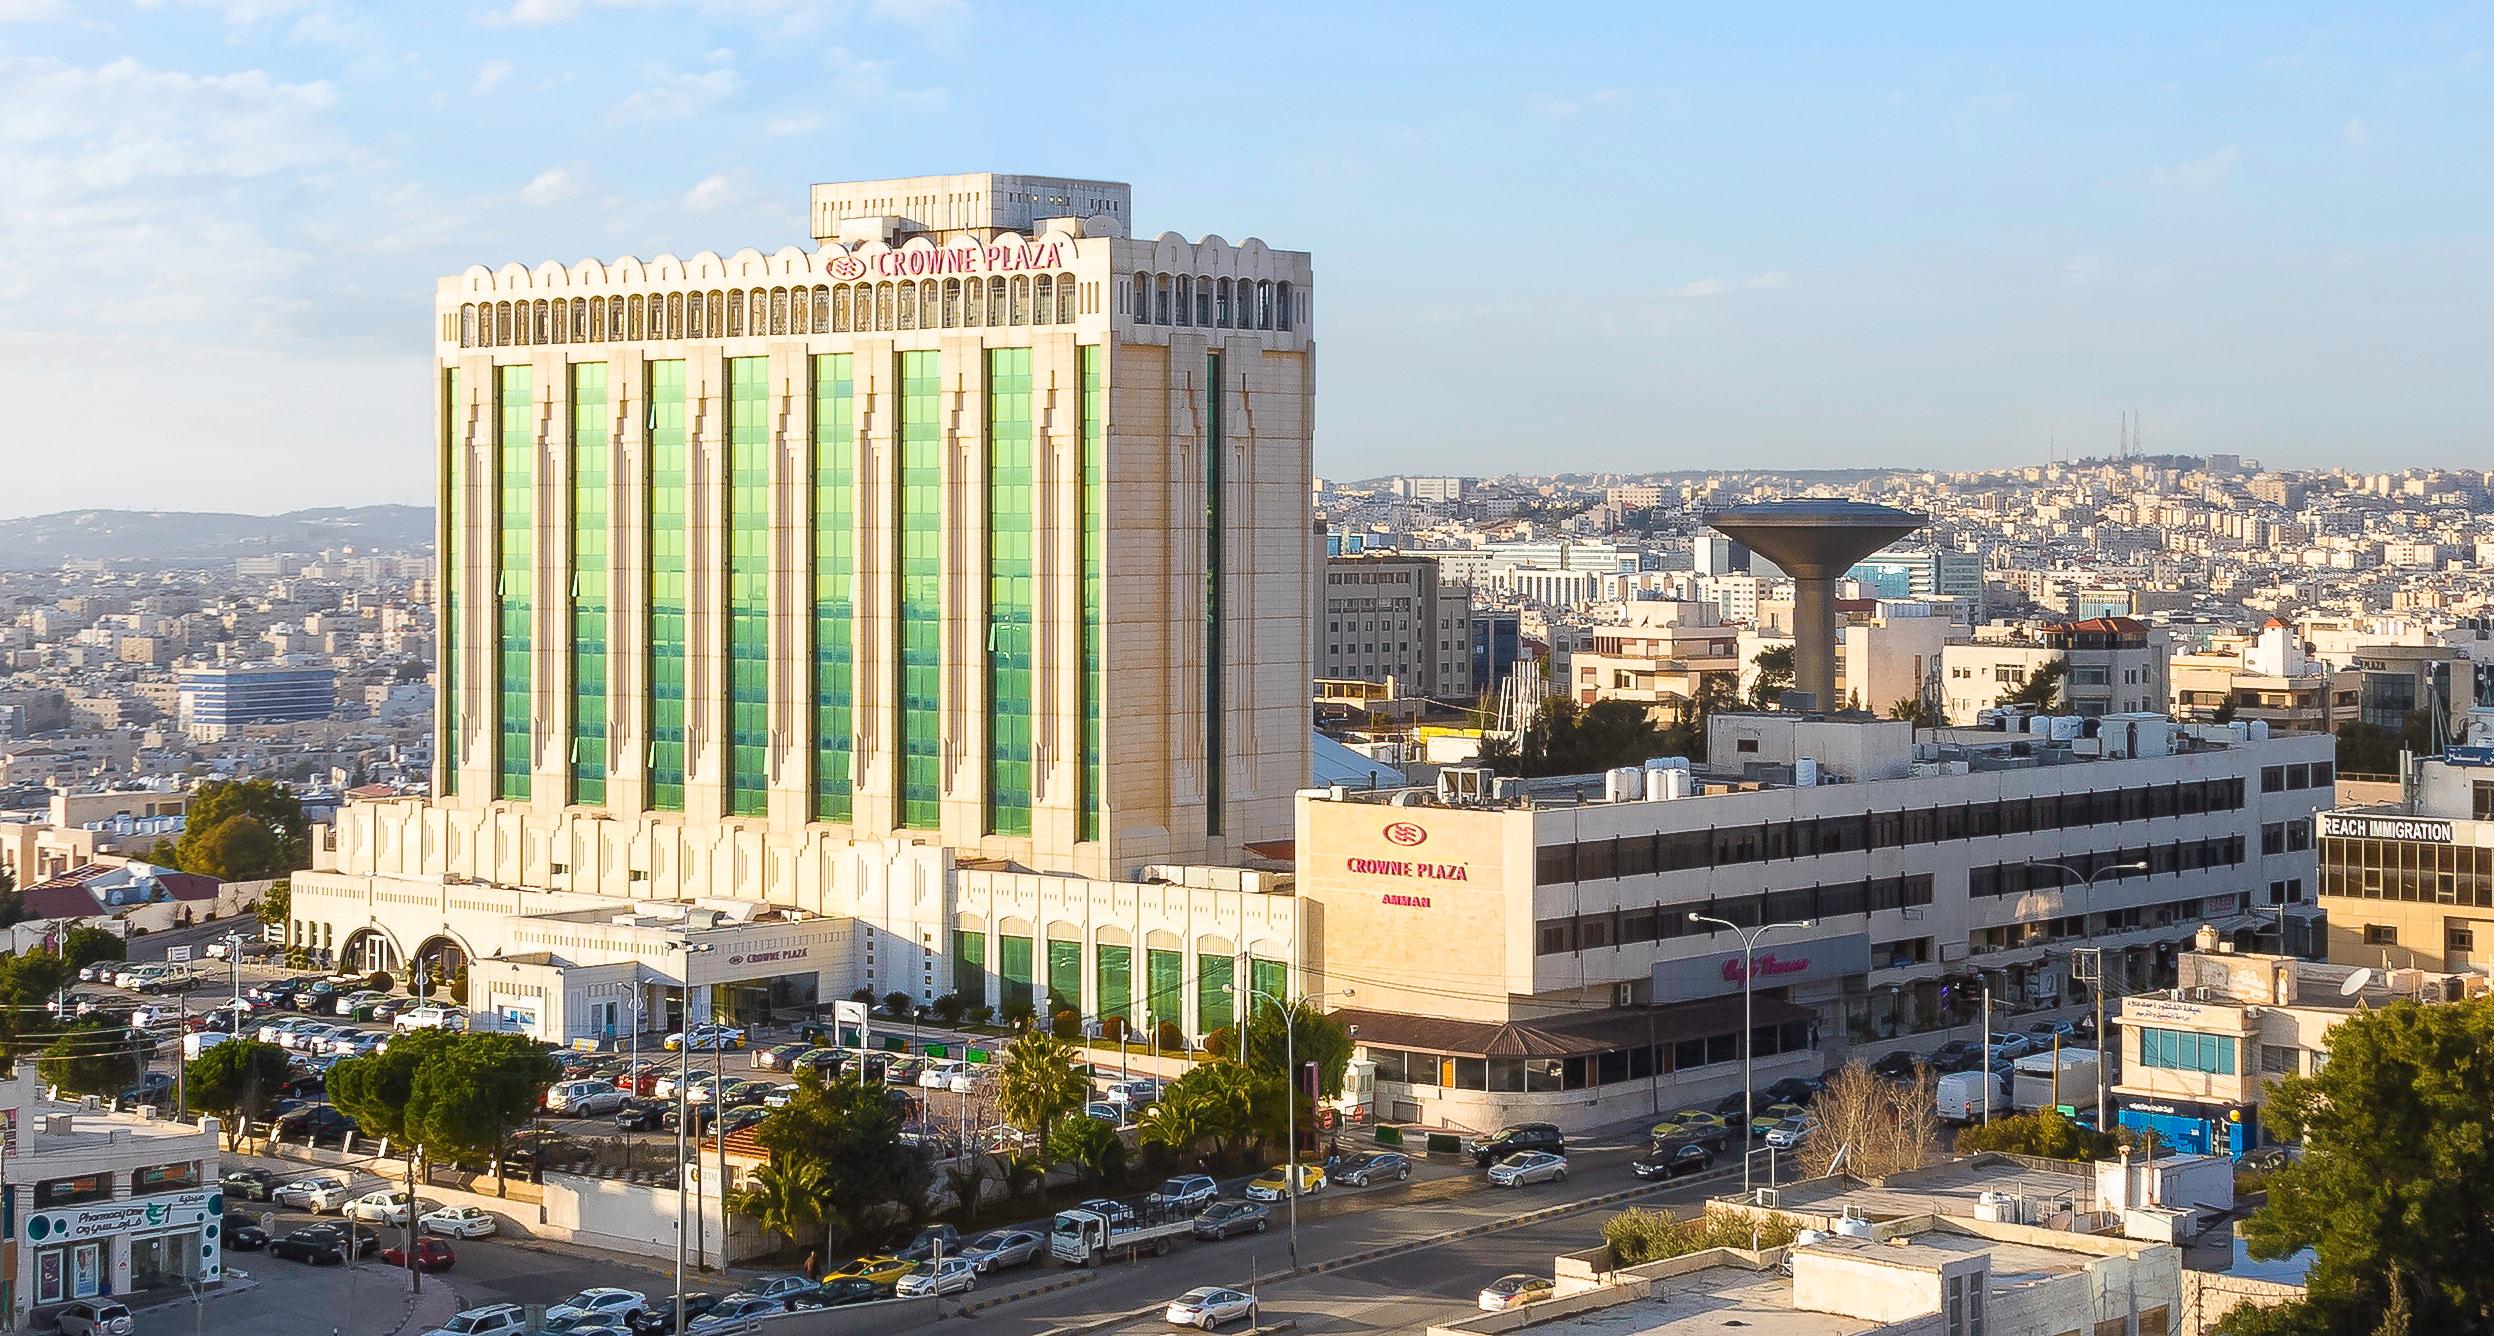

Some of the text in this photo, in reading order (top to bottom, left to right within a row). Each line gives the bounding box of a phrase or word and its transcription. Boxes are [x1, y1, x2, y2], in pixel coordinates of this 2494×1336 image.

[878, 242, 1063, 276] CROWNE PLAZA
[2324, 818, 2451, 841] REACH IMMIGRATION
[1346, 858, 1468, 881] CROWNE PLAZA
[1382, 893, 1431, 908] AMMAN
[747, 948, 808, 963] CROWNE PLAZA
[78, 1210, 126, 1223] Pharmacy
